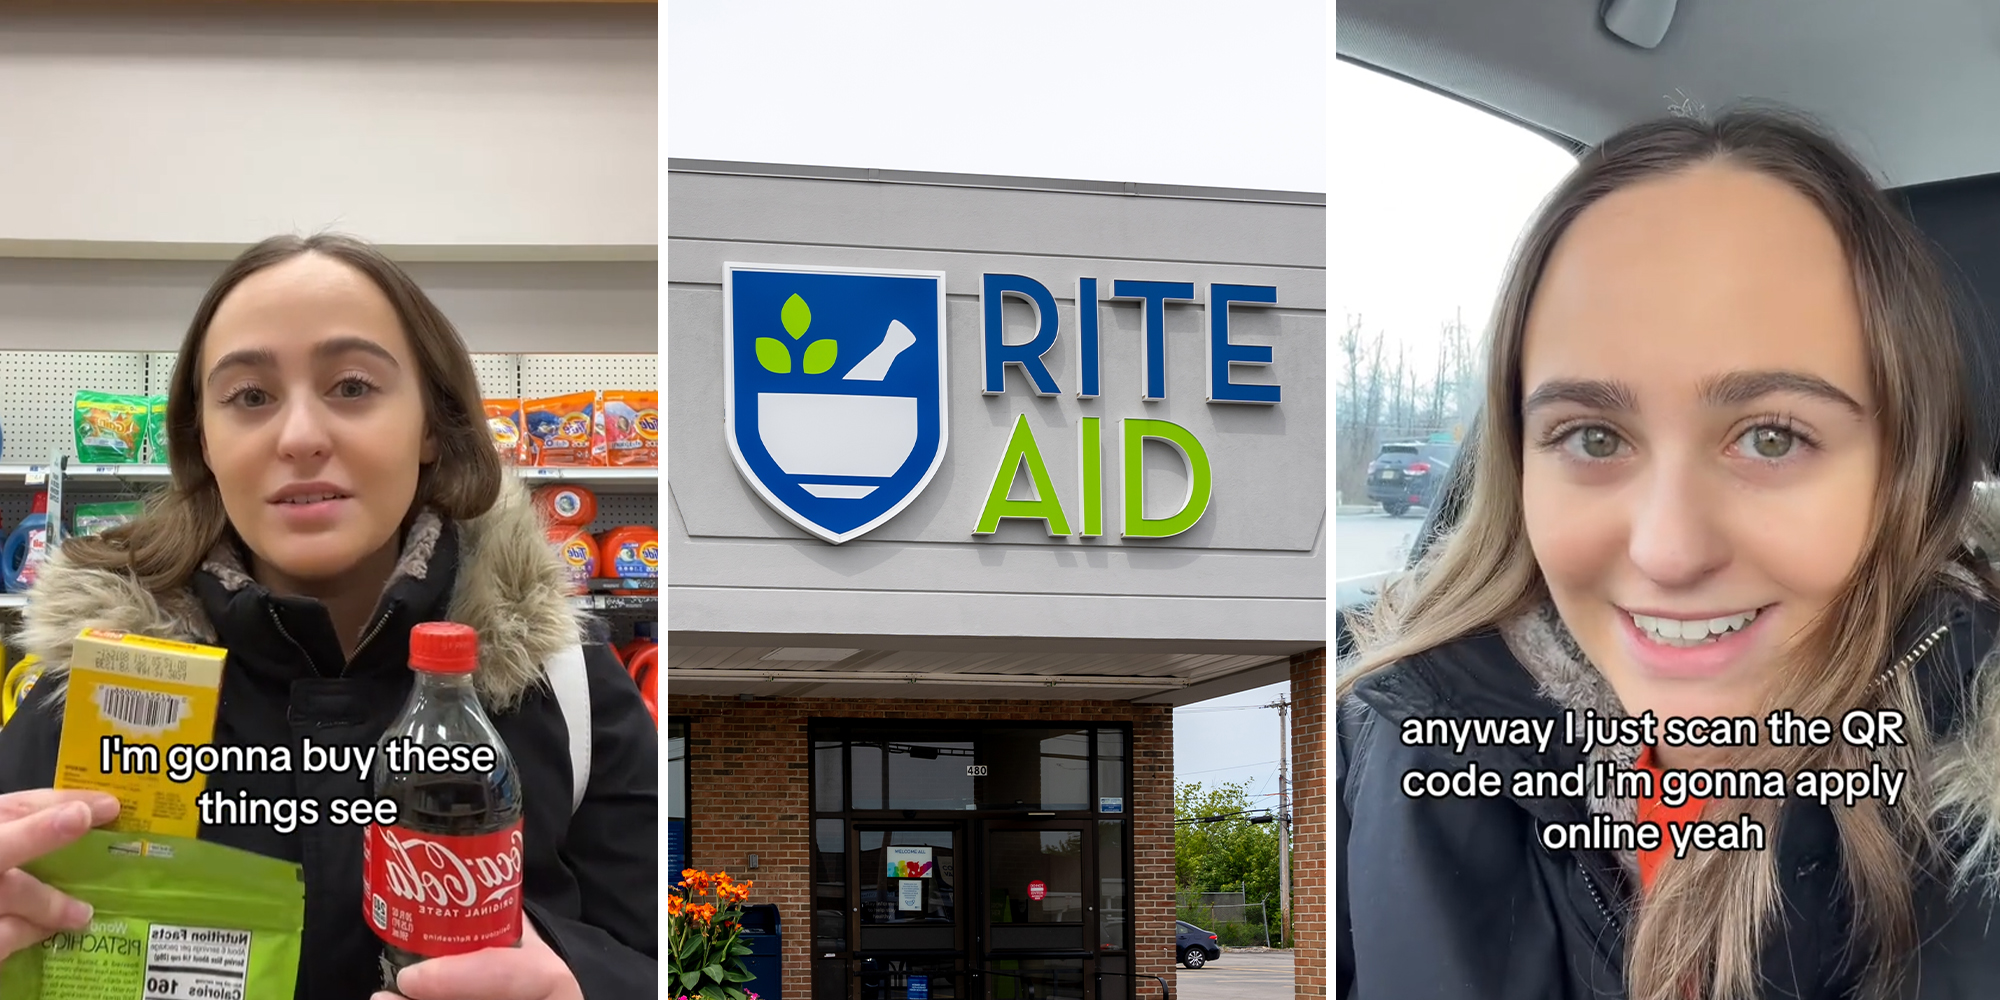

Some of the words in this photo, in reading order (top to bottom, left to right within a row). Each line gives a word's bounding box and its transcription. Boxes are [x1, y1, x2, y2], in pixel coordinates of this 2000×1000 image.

[980, 273, 1282, 405] RITE
[971, 412, 1213, 540] AID
[967, 766, 987, 775] 480
